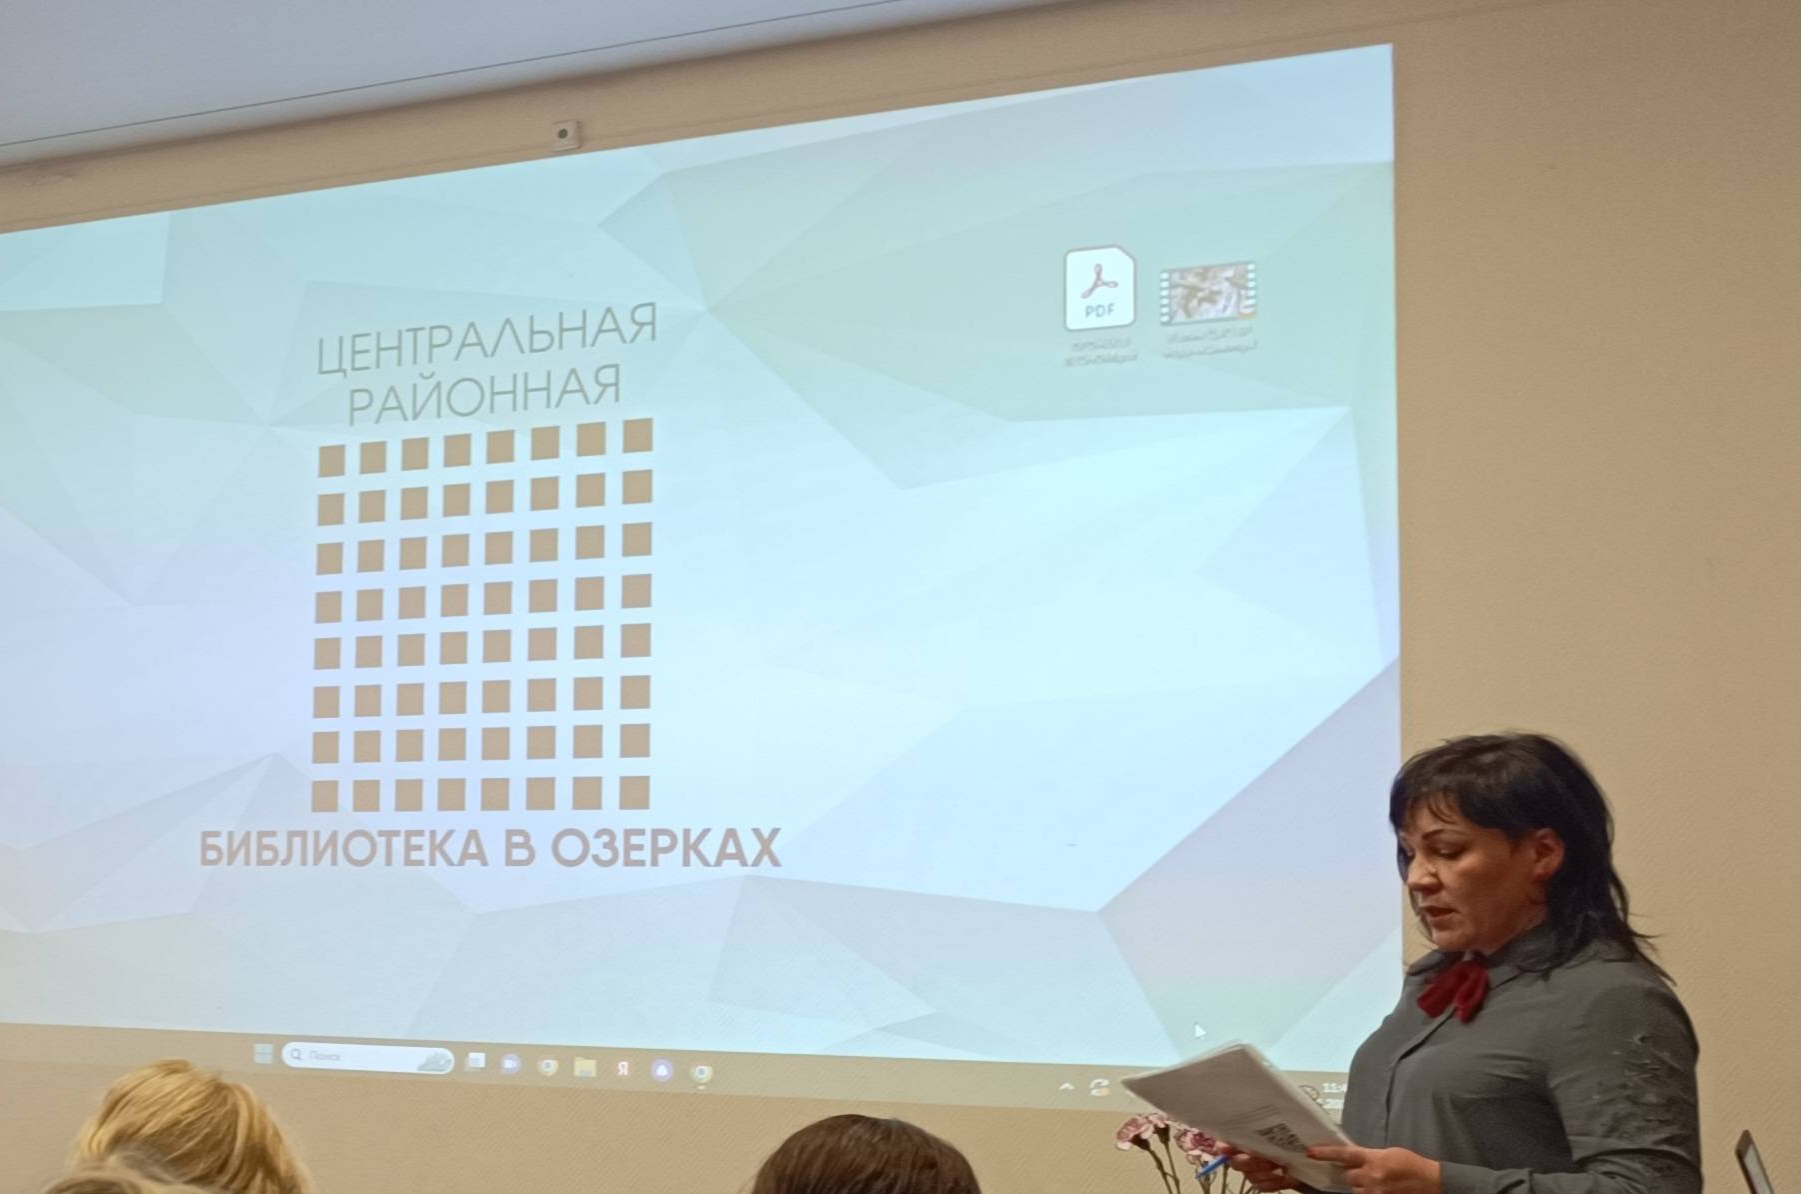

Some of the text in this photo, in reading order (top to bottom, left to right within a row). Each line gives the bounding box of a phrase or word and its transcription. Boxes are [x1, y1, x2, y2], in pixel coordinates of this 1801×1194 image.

[1085, 302, 1115, 319] PDF
[316, 302, 659, 379] ЦЕНТРАЛЬНАЯ
[348, 363, 621, 427] РАЙОННАЯ
[199, 827, 784, 869] БИБЛИОТЕКА В ОЗЕРКАХ
